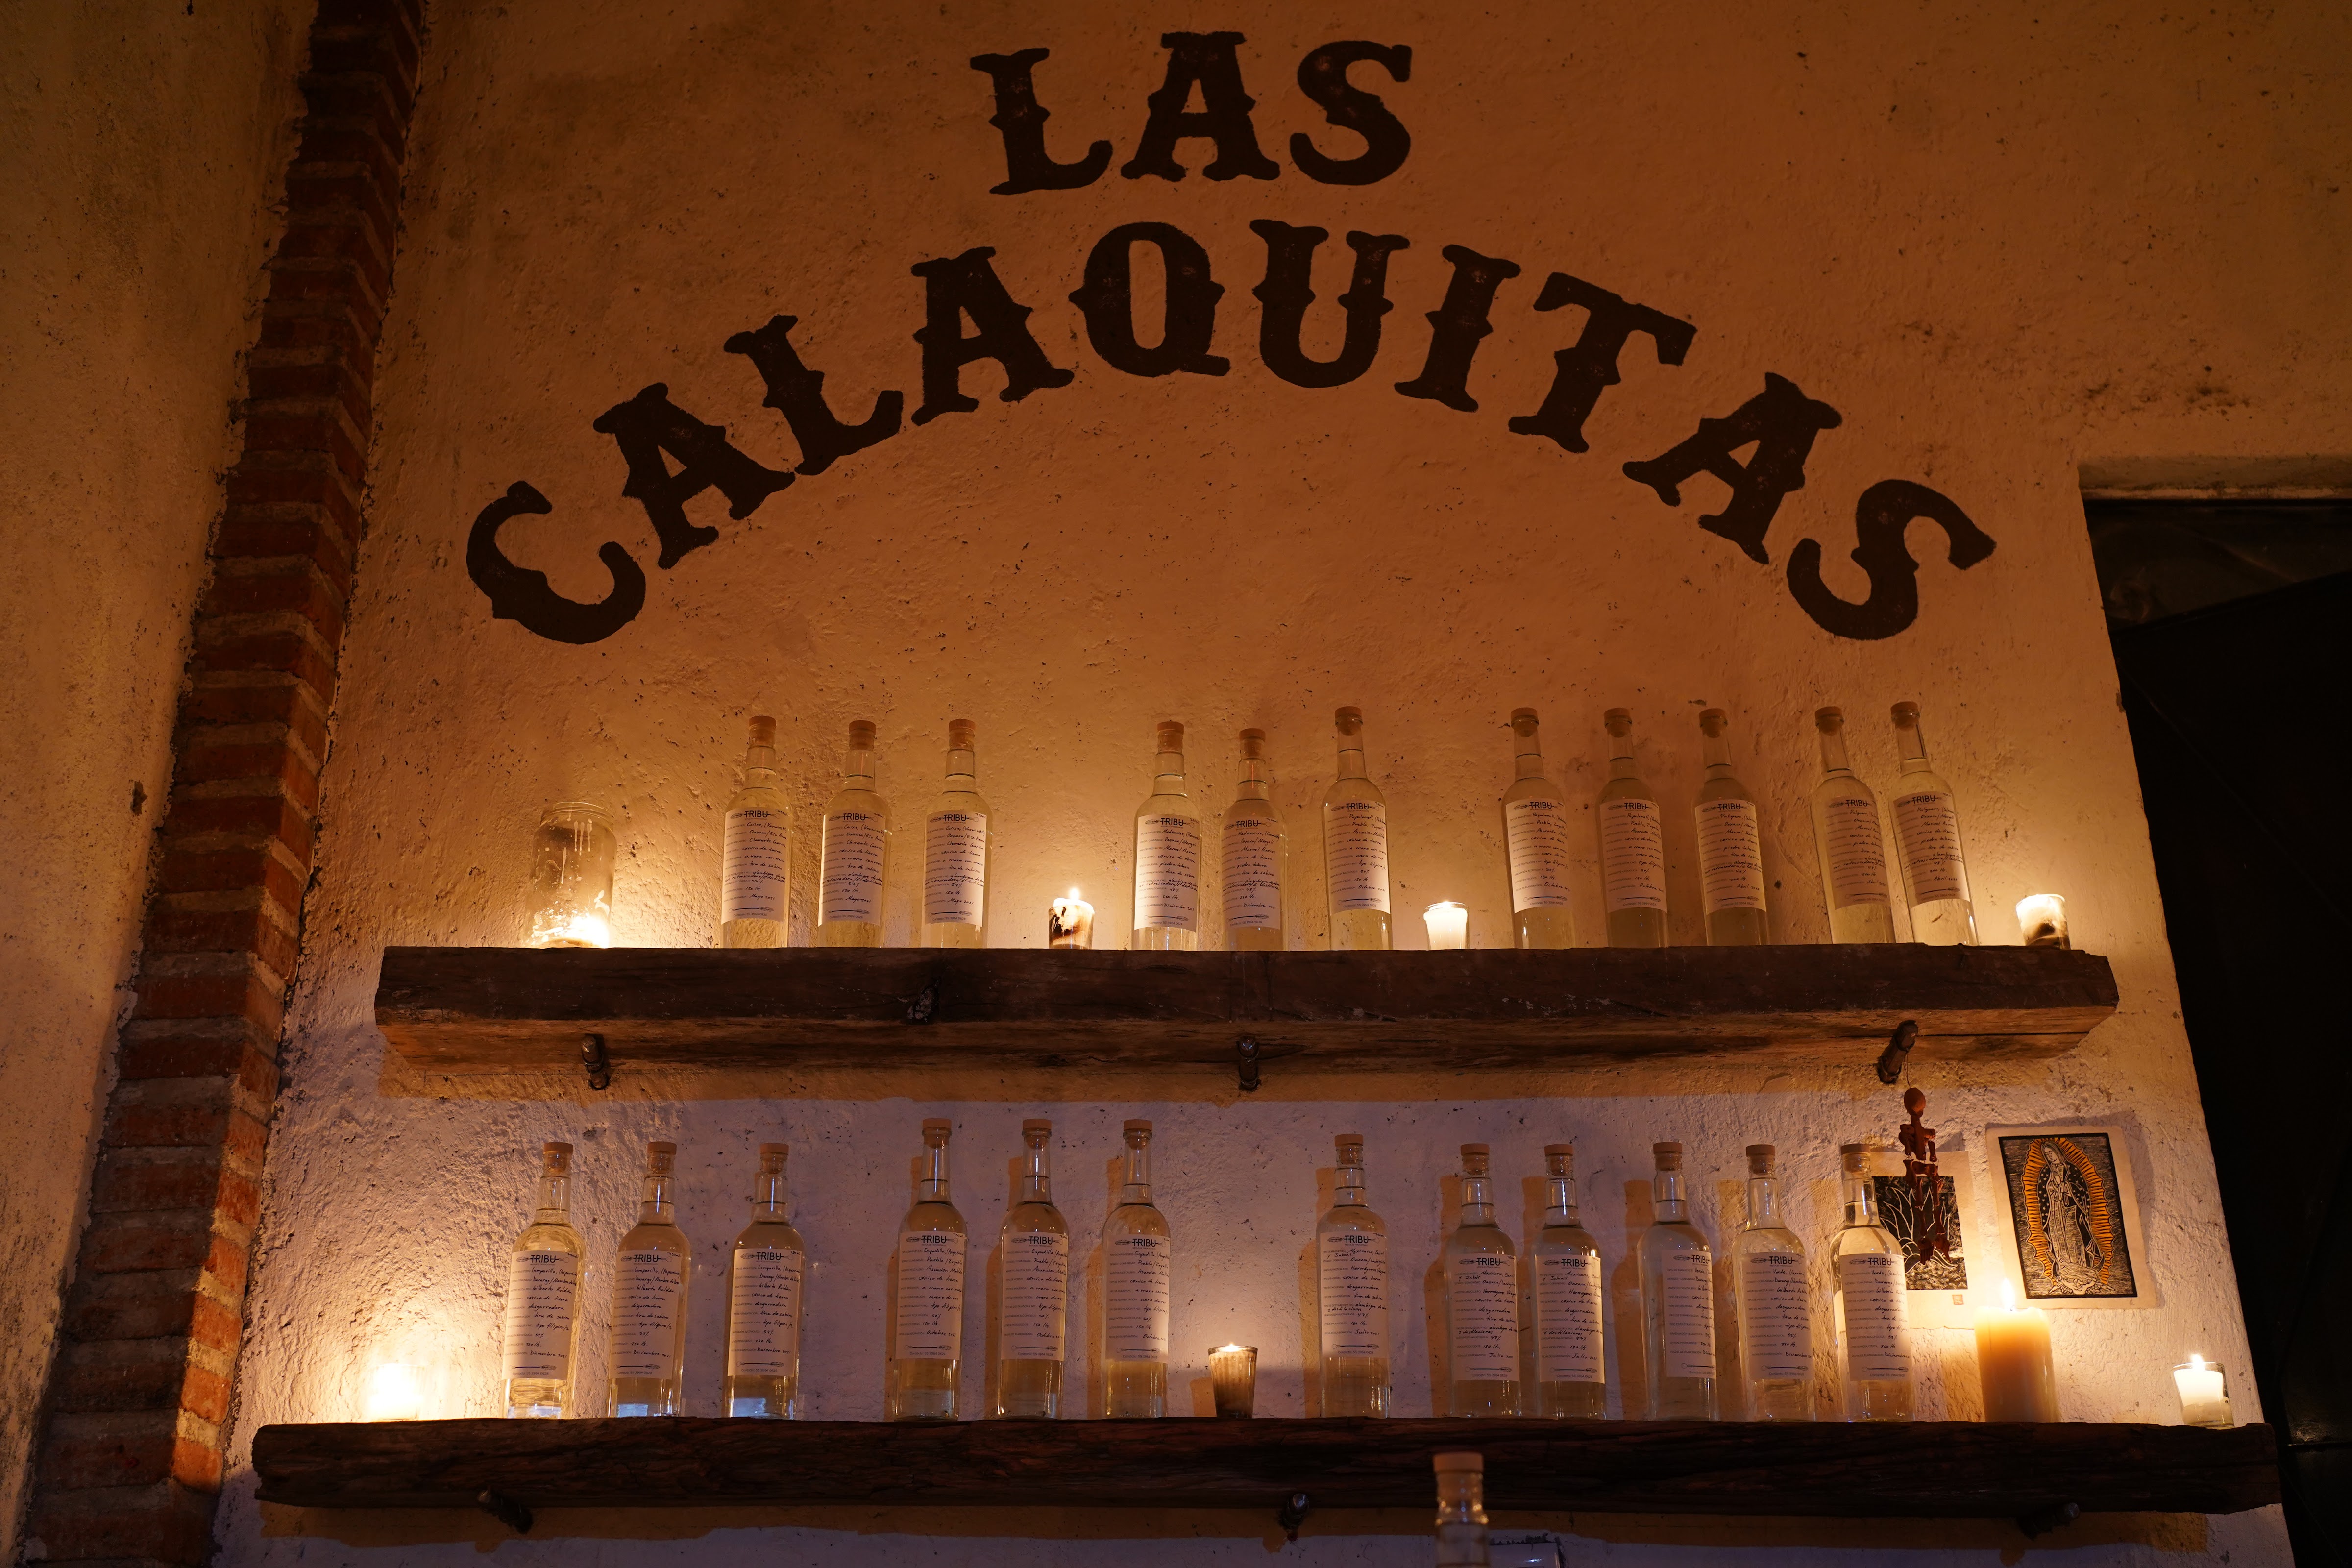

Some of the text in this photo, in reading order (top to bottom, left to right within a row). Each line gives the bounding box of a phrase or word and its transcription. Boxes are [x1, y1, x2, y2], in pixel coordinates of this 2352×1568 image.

[970, 31, 1412, 195] LAS
[467, 219, 1996, 645] CALAQUITAS
[1912, 795, 1936, 804] TRIBU
[1236, 820, 1258, 828] TRIBU
[1920, 837, 1937, 845] piedra
[922, 1235, 946, 1244] TRIBU
[1029, 1236, 1053, 1245] TRIBU
[1132, 1238, 1156, 1247] TRIBU
[531, 1255, 556, 1263] TRIBU
[756, 1252, 782, 1261] TRIBU
[1692, 1255, 1709, 1264] TRIBU
[1868, 1257, 1892, 1266] TRIBU
